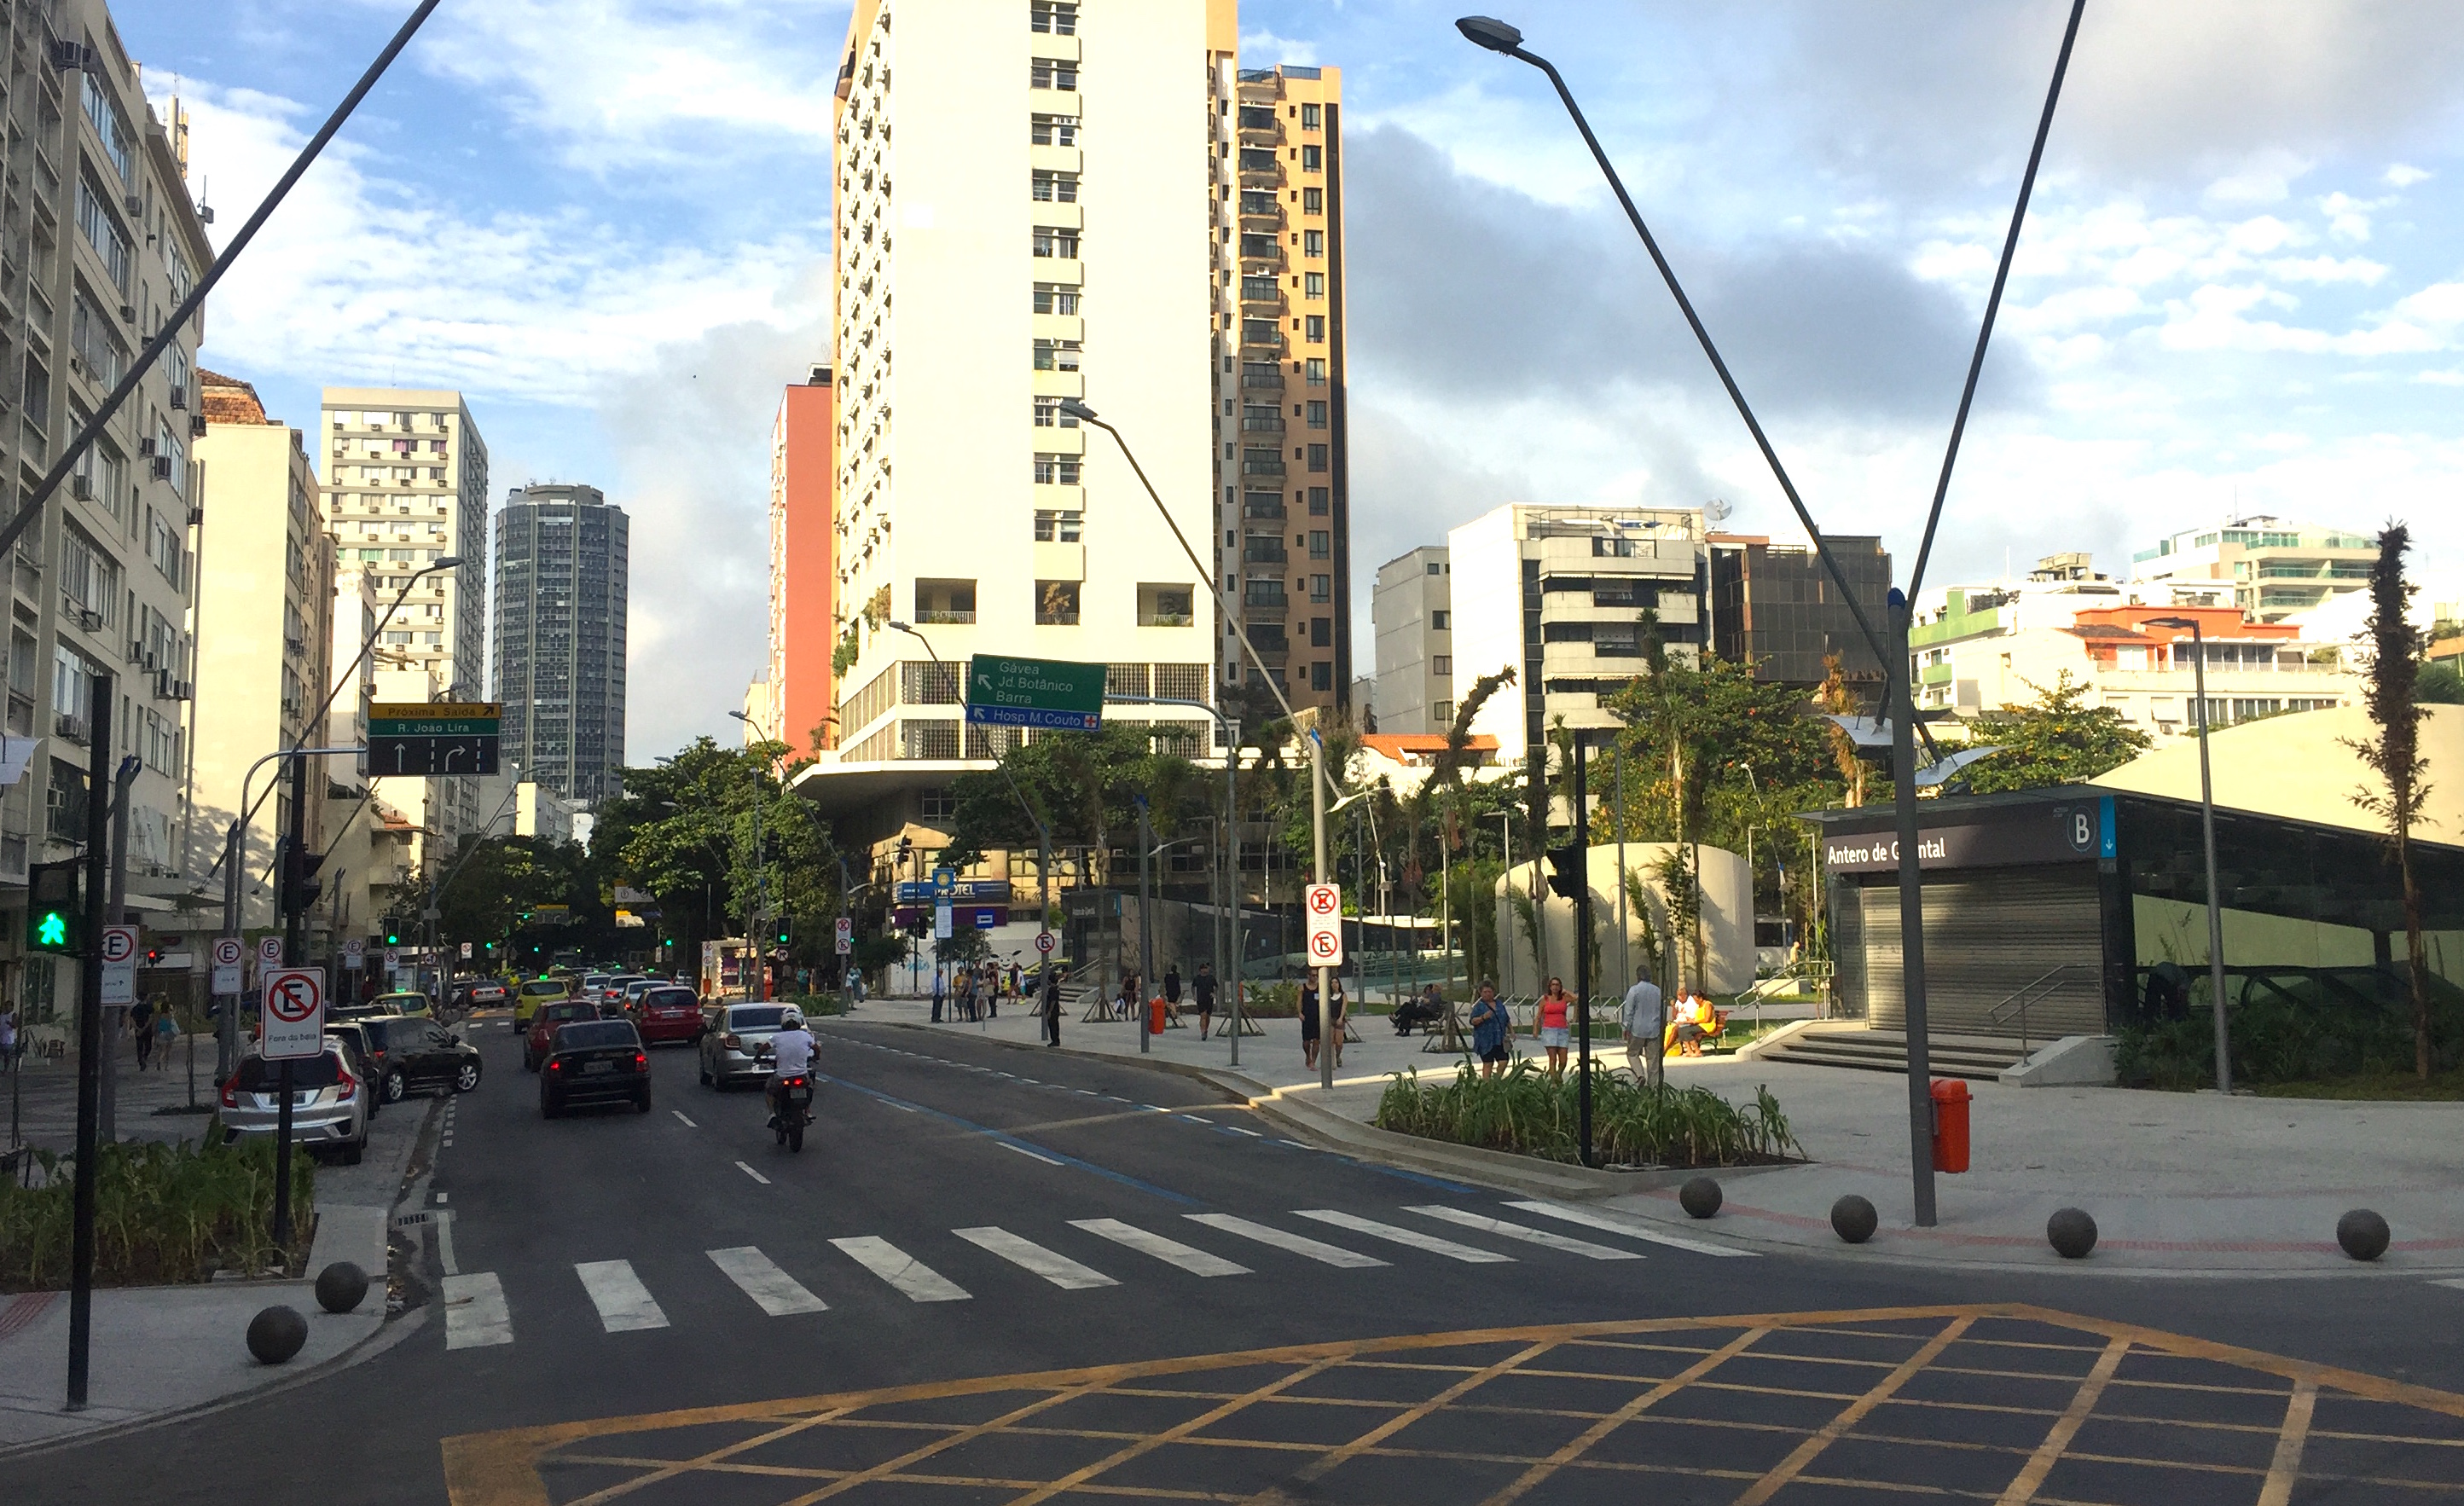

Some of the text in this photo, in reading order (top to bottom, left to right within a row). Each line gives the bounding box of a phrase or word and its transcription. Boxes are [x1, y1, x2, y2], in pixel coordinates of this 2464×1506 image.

[999, 661, 1040, 675] Gávea
[998, 675, 1074, 692] Jd. Botânico
[995, 691, 1032, 704] Barra
[387, 707, 436, 716] Próxima
[1029, 714, 1043, 724] M.
[1044, 713, 1081, 726] Couto
[397, 723, 410, 733] R.
[447, 723, 470, 733] Lira
[2075, 813, 2090, 844] B
[1827, 845, 1869, 866] Antero
[1872, 842, 1887, 861] de
[108, 935, 123, 956] E
[267, 943, 275, 955] E
[223, 946, 234, 959] E
